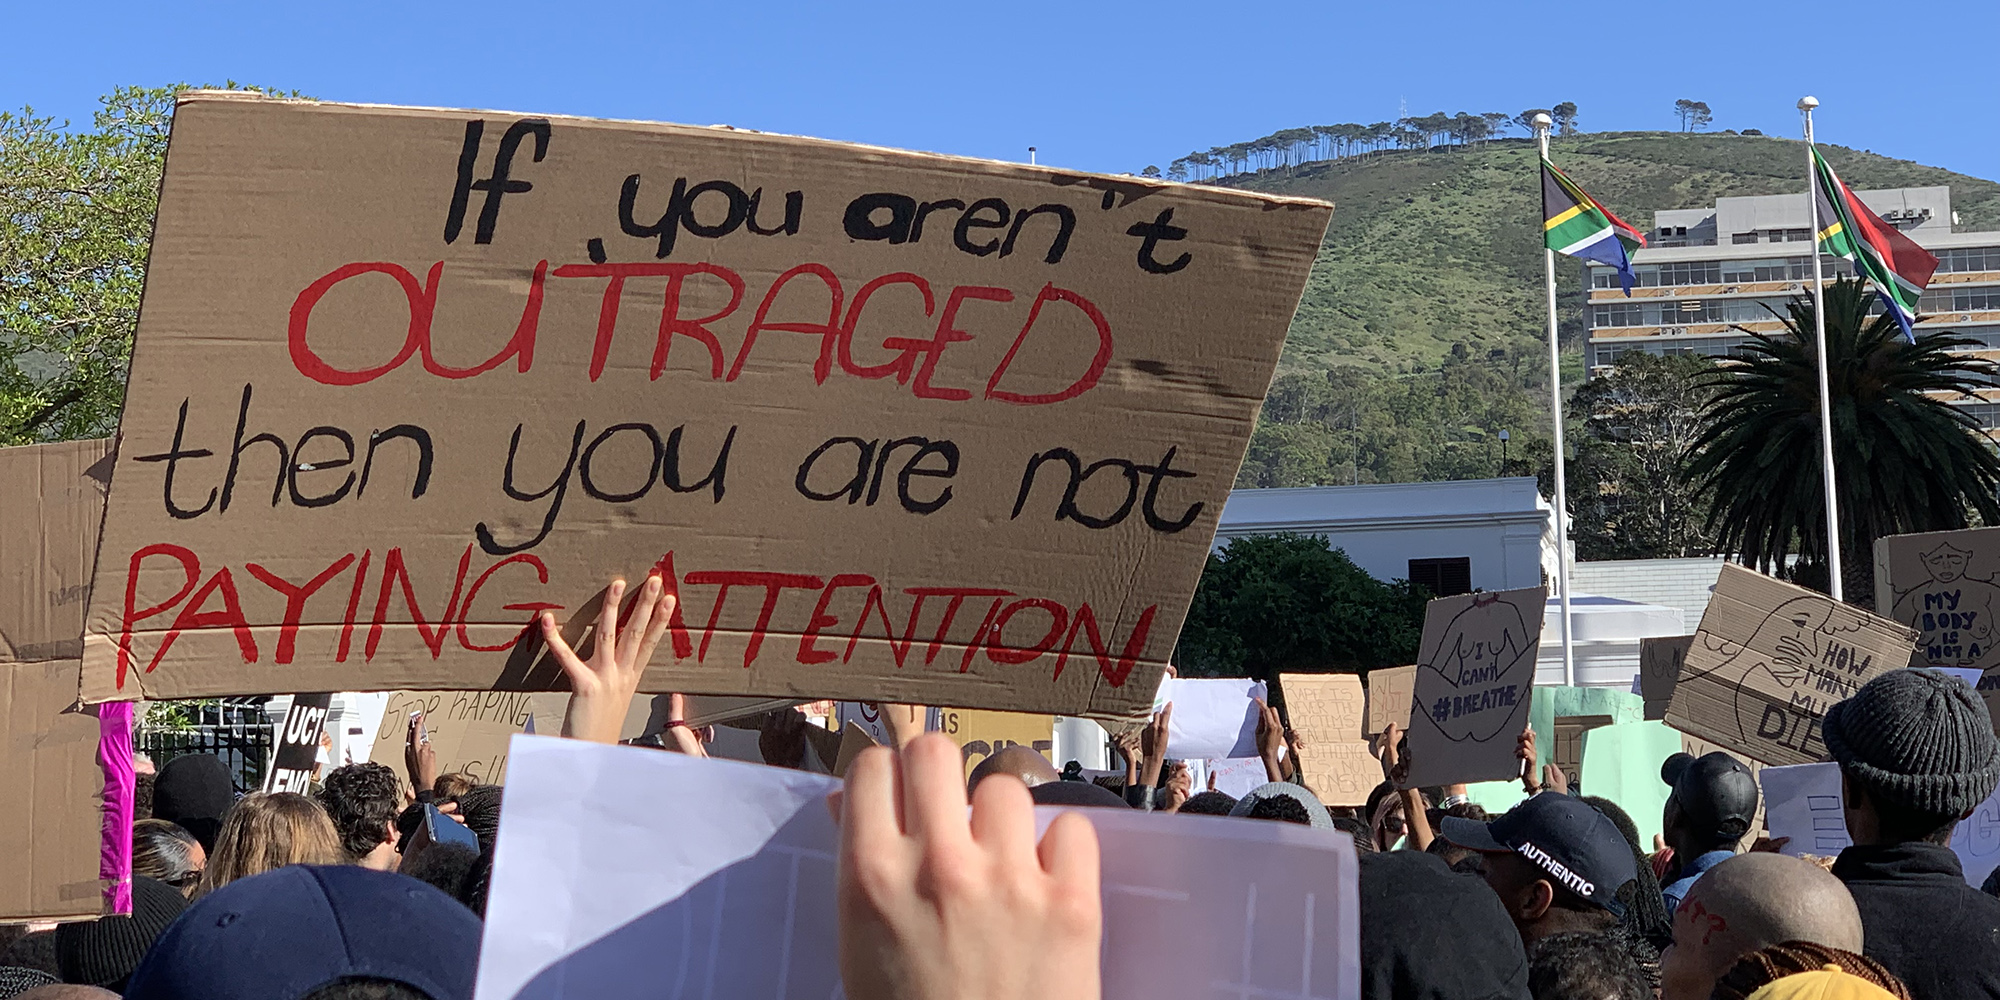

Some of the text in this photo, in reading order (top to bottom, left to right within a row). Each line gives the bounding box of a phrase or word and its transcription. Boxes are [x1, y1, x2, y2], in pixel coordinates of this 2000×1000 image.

[443, 118, 552, 246] If
[588, 173, 801, 265] you
[288, 258, 1113, 405] OUTRAGED
[133, 382, 1205, 555] then you are not
[1924, 588, 1961, 611] MY
[115, 542, 1158, 692] PAYING ATTENTION
[1922, 611, 1978, 632] BODY
[1928, 642, 1981, 660] NOT A
[1942, 631, 1959, 645] IS
[1822, 640, 1872, 677] HOW
[1283, 681, 1354, 701] RAPE IS
[1432, 684, 1518, 722] #BREATHE
[381, 692, 441, 740] STOP
[1287, 701, 1328, 715] NEVER
[1341, 759, 1367, 774] NOT
[1305, 773, 1382, 794] CONSENT
[1518, 842, 1595, 896] AUTHENTIC
